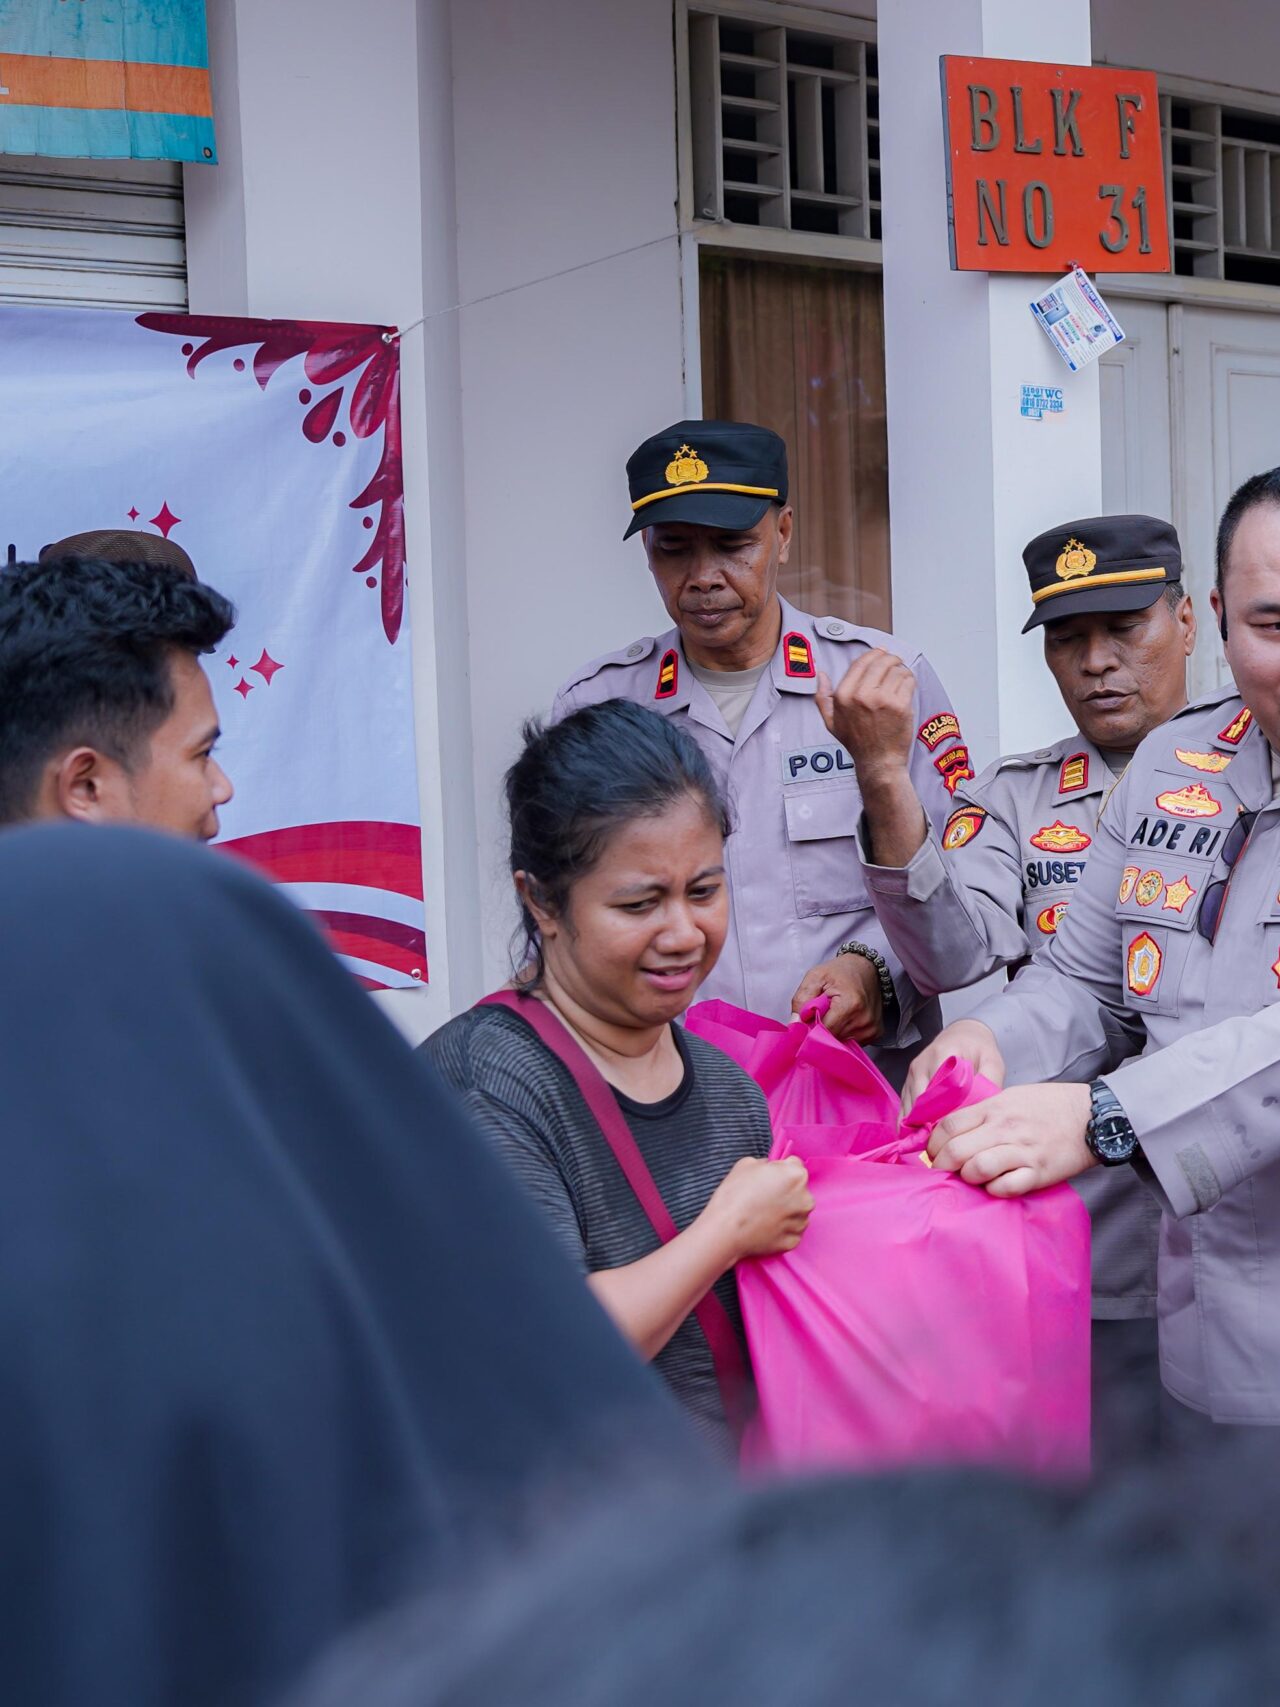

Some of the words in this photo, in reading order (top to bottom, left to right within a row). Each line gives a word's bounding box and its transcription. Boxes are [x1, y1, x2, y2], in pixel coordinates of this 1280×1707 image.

[967, 85, 1084, 156] BLK
[1116, 94, 1142, 159] F
[976, 180, 1054, 248] NO
[1099, 185, 1152, 253] 31
[1045, 389, 1063, 399] WC
[788, 749, 855, 778] POL
[1130, 817, 1186, 850] ADE
